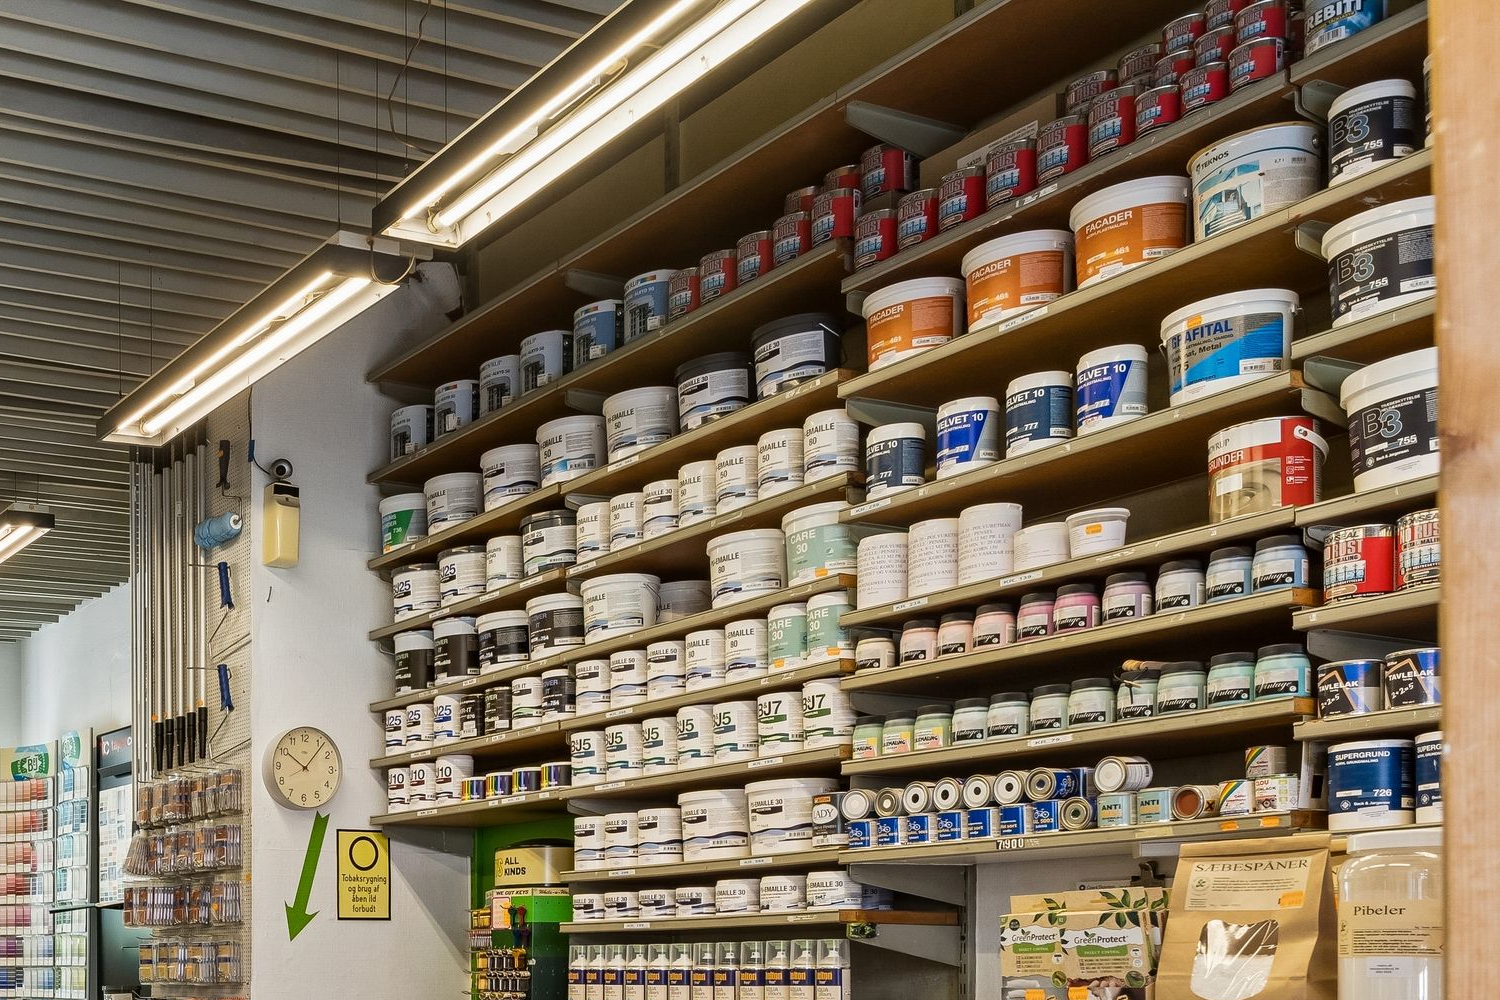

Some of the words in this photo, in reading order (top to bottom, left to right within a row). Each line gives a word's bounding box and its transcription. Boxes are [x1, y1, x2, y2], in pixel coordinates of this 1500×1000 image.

[1331, 114, 1370, 148] B3
[1363, 139, 1383, 150] 755
[1201, 151, 1229, 168] TEKNOS
[1086, 210, 1133, 234] FACADER
[972, 259, 1011, 281] FACADER
[1336, 252, 1375, 285] B3
[1368, 277, 1389, 289] 755
[869, 304, 904, 324] FACADER
[1198, 341, 1222, 354] Metal
[1113, 363, 1127, 374] 10
[1032, 388, 1045, 397] 10
[972, 412, 984, 422] 10
[1023, 422, 1039, 431] 777
[1361, 408, 1403, 440] B3
[809, 436, 817, 446] 80
[887, 440, 898, 449] 10
[1397, 434, 1418, 446] 755
[544, 448, 552, 459] 50
[762, 454, 770, 463] 50
[719, 470, 728, 479] 50
[879, 470, 893, 479] 777
[790, 529, 816, 544] CARE
[796, 543, 808, 555] 30
[717, 565, 726, 574] 80
[768, 618, 792, 632] CARE
[809, 621, 820, 631] 30
[772, 630, 783, 640] 30
[730, 639, 738, 648] 80
[1388, 669, 1434, 682] TAVLELAK
[1318, 680, 1359, 692] TAVLELAK
[289, 737, 296, 746] 11
[300, 734, 309, 743] 12
[280, 748, 288, 756] 10
[325, 751, 330, 759] 2
[1334, 750, 1391, 761] SUPERGRUND
[276, 762, 282, 770] 9
[328, 766, 334, 774] 3
[279, 777, 285, 785] 8
[288, 789, 294, 797] 7
[314, 791, 320, 799] 5
[1372, 788, 1392, 797] 726
[301, 794, 307, 802] 6
[1140, 799, 1160, 807] ANTI
[1101, 803, 1122, 811] ANTI
[504, 856, 519, 865] ALL
[1194, 858, 1309, 873] SÆBESPÅNER
[504, 866, 526, 876] KINDS
[341, 873, 387, 885] Tobaksrygning
[348, 886, 356, 894] og
[357, 885, 373, 894] brug
[374, 884, 380, 893] af
[352, 894, 367, 903] åben
[368, 894, 377, 903] ild
[352, 905, 376, 913] forbudt
[1353, 904, 1407, 916] Pibeler
